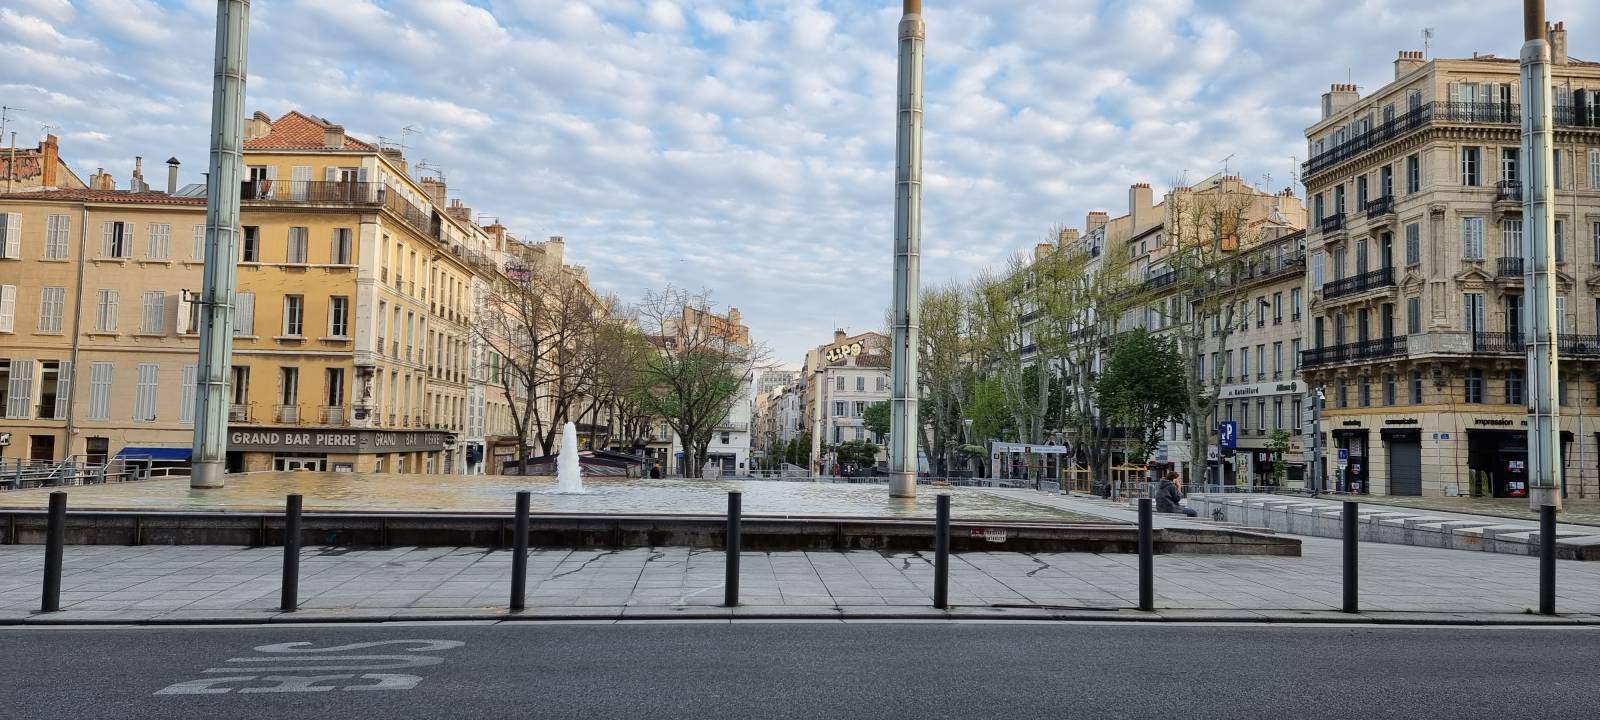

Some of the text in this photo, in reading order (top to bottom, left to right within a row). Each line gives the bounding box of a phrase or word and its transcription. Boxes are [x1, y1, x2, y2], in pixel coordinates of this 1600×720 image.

[1475, 417, 1514, 426] impression
[232, 432, 357, 446] GRAND BAR PIERRE
[1226, 424, 1233, 440] P
[375, 433, 440, 447] GRAND BAR PIERRE
[153, 639, 466, 695] BUS
